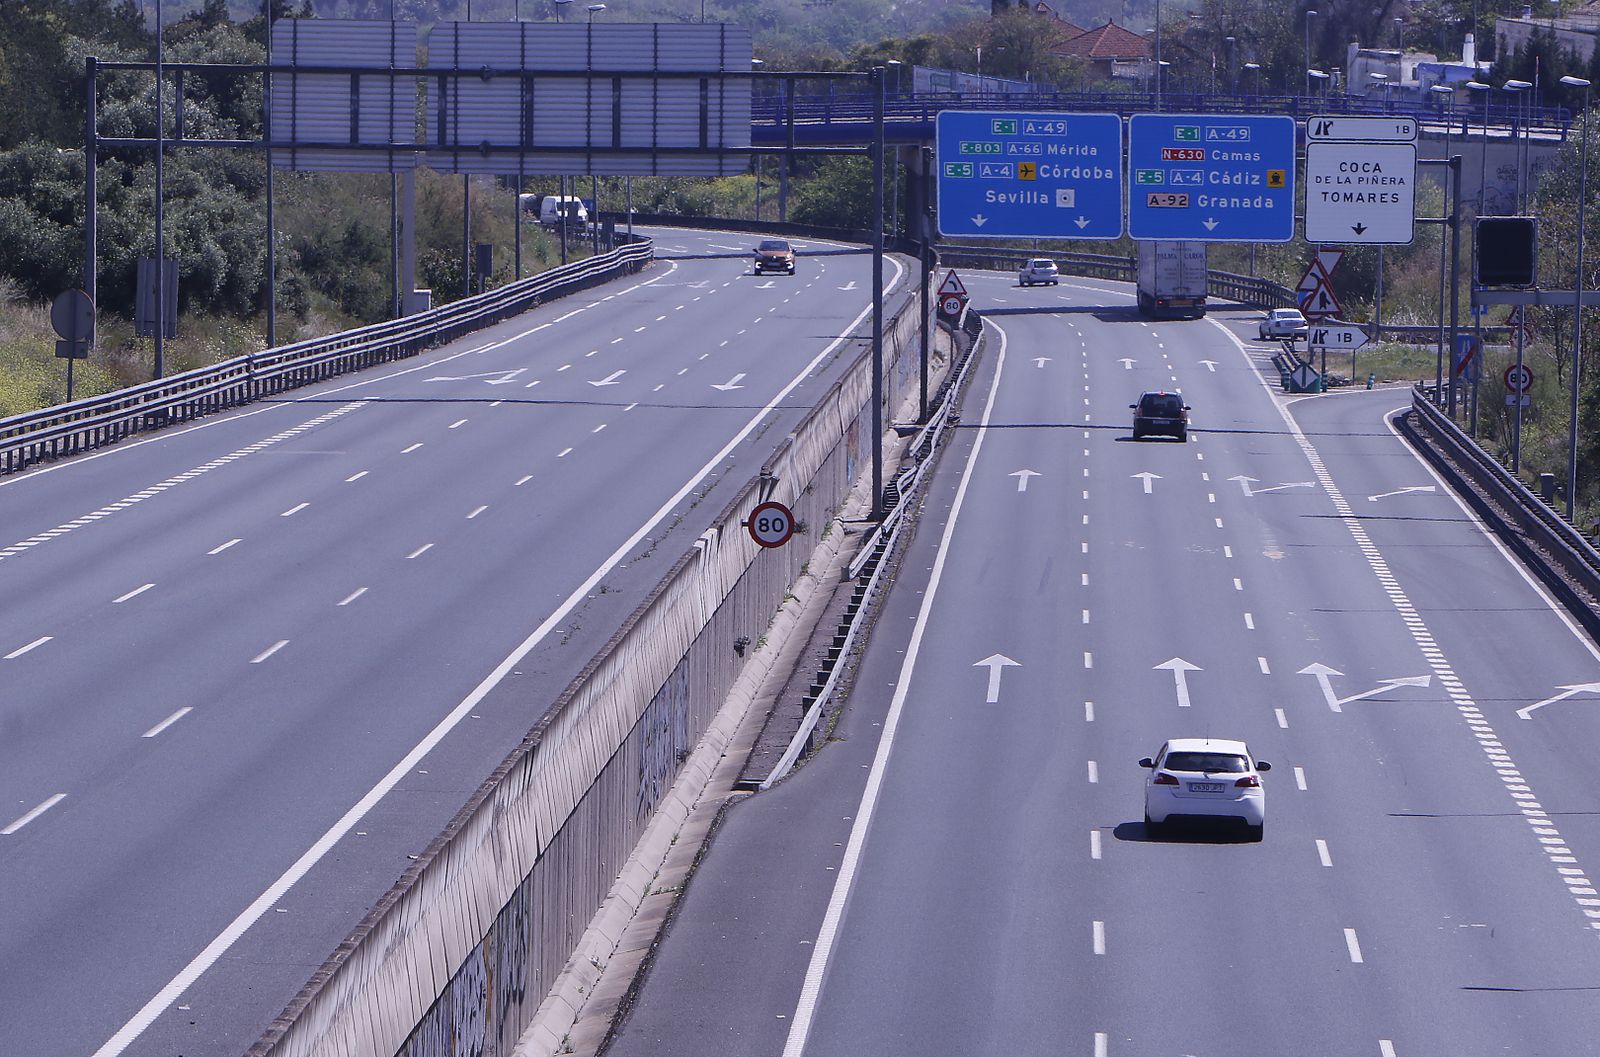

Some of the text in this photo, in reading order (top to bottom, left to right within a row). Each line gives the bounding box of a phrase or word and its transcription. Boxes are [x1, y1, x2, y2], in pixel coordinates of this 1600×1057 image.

[994, 121, 1065, 134] E-1 A-49
[1176, 128, 1249, 140] E-1 A-49
[1395, 125, 1410, 134] 1B
[961, 143, 1098, 156] E-803 A-66 Mérida
[1162, 150, 1261, 161] N-630 Camas
[945, 164, 1114, 179] E-5 A-4 Córdoba
[1339, 161, 1383, 173] COCA
[1137, 171, 1261, 185] E-5 A-4 Cádiz
[1315, 174, 1406, 186] DE LA PIÑERA
[985, 190, 1049, 204] Sevilla
[1149, 194, 1274, 209] A-92 Granada
[1321, 191, 1400, 204] TOMARES
[946, 301, 959, 310] 80
[1337, 332, 1353, 343] 1B
[758, 517, 785, 533] 80
